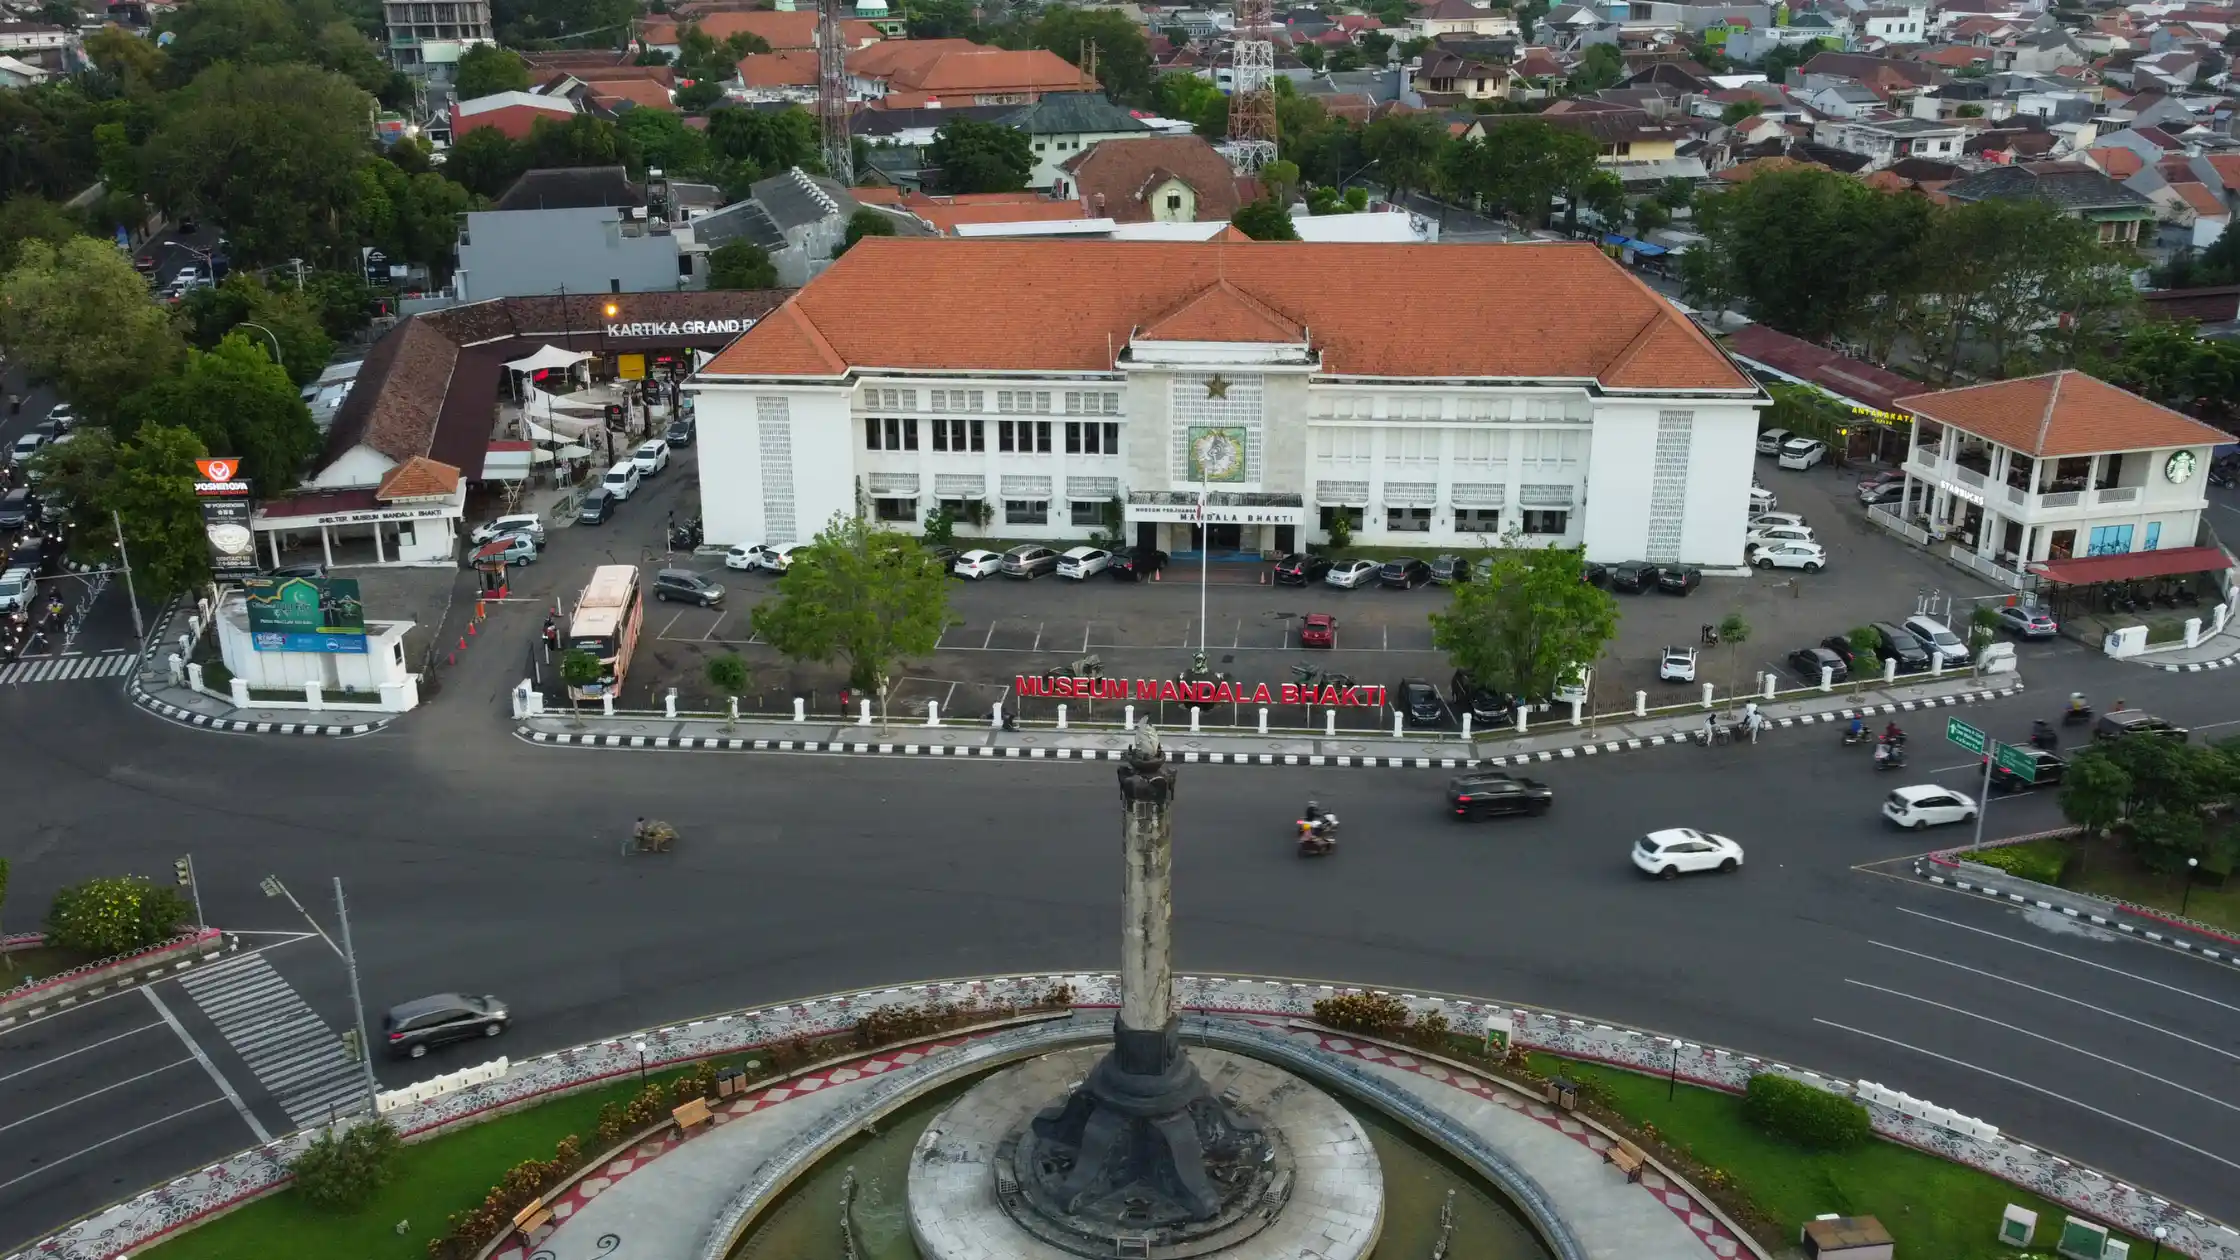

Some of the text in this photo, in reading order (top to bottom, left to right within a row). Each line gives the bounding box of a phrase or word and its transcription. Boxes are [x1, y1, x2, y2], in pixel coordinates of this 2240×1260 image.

[607, 321, 680, 337] KARTIKA
[682, 319, 740, 334] GRAND
[318, 516, 347, 524] SHELTER
[382, 511, 414, 519] MANDALA
[1247, 514, 1293, 523] BHAKTI
[1015, 674, 1386, 707] MUSEUM MANDALA BHAKTI
